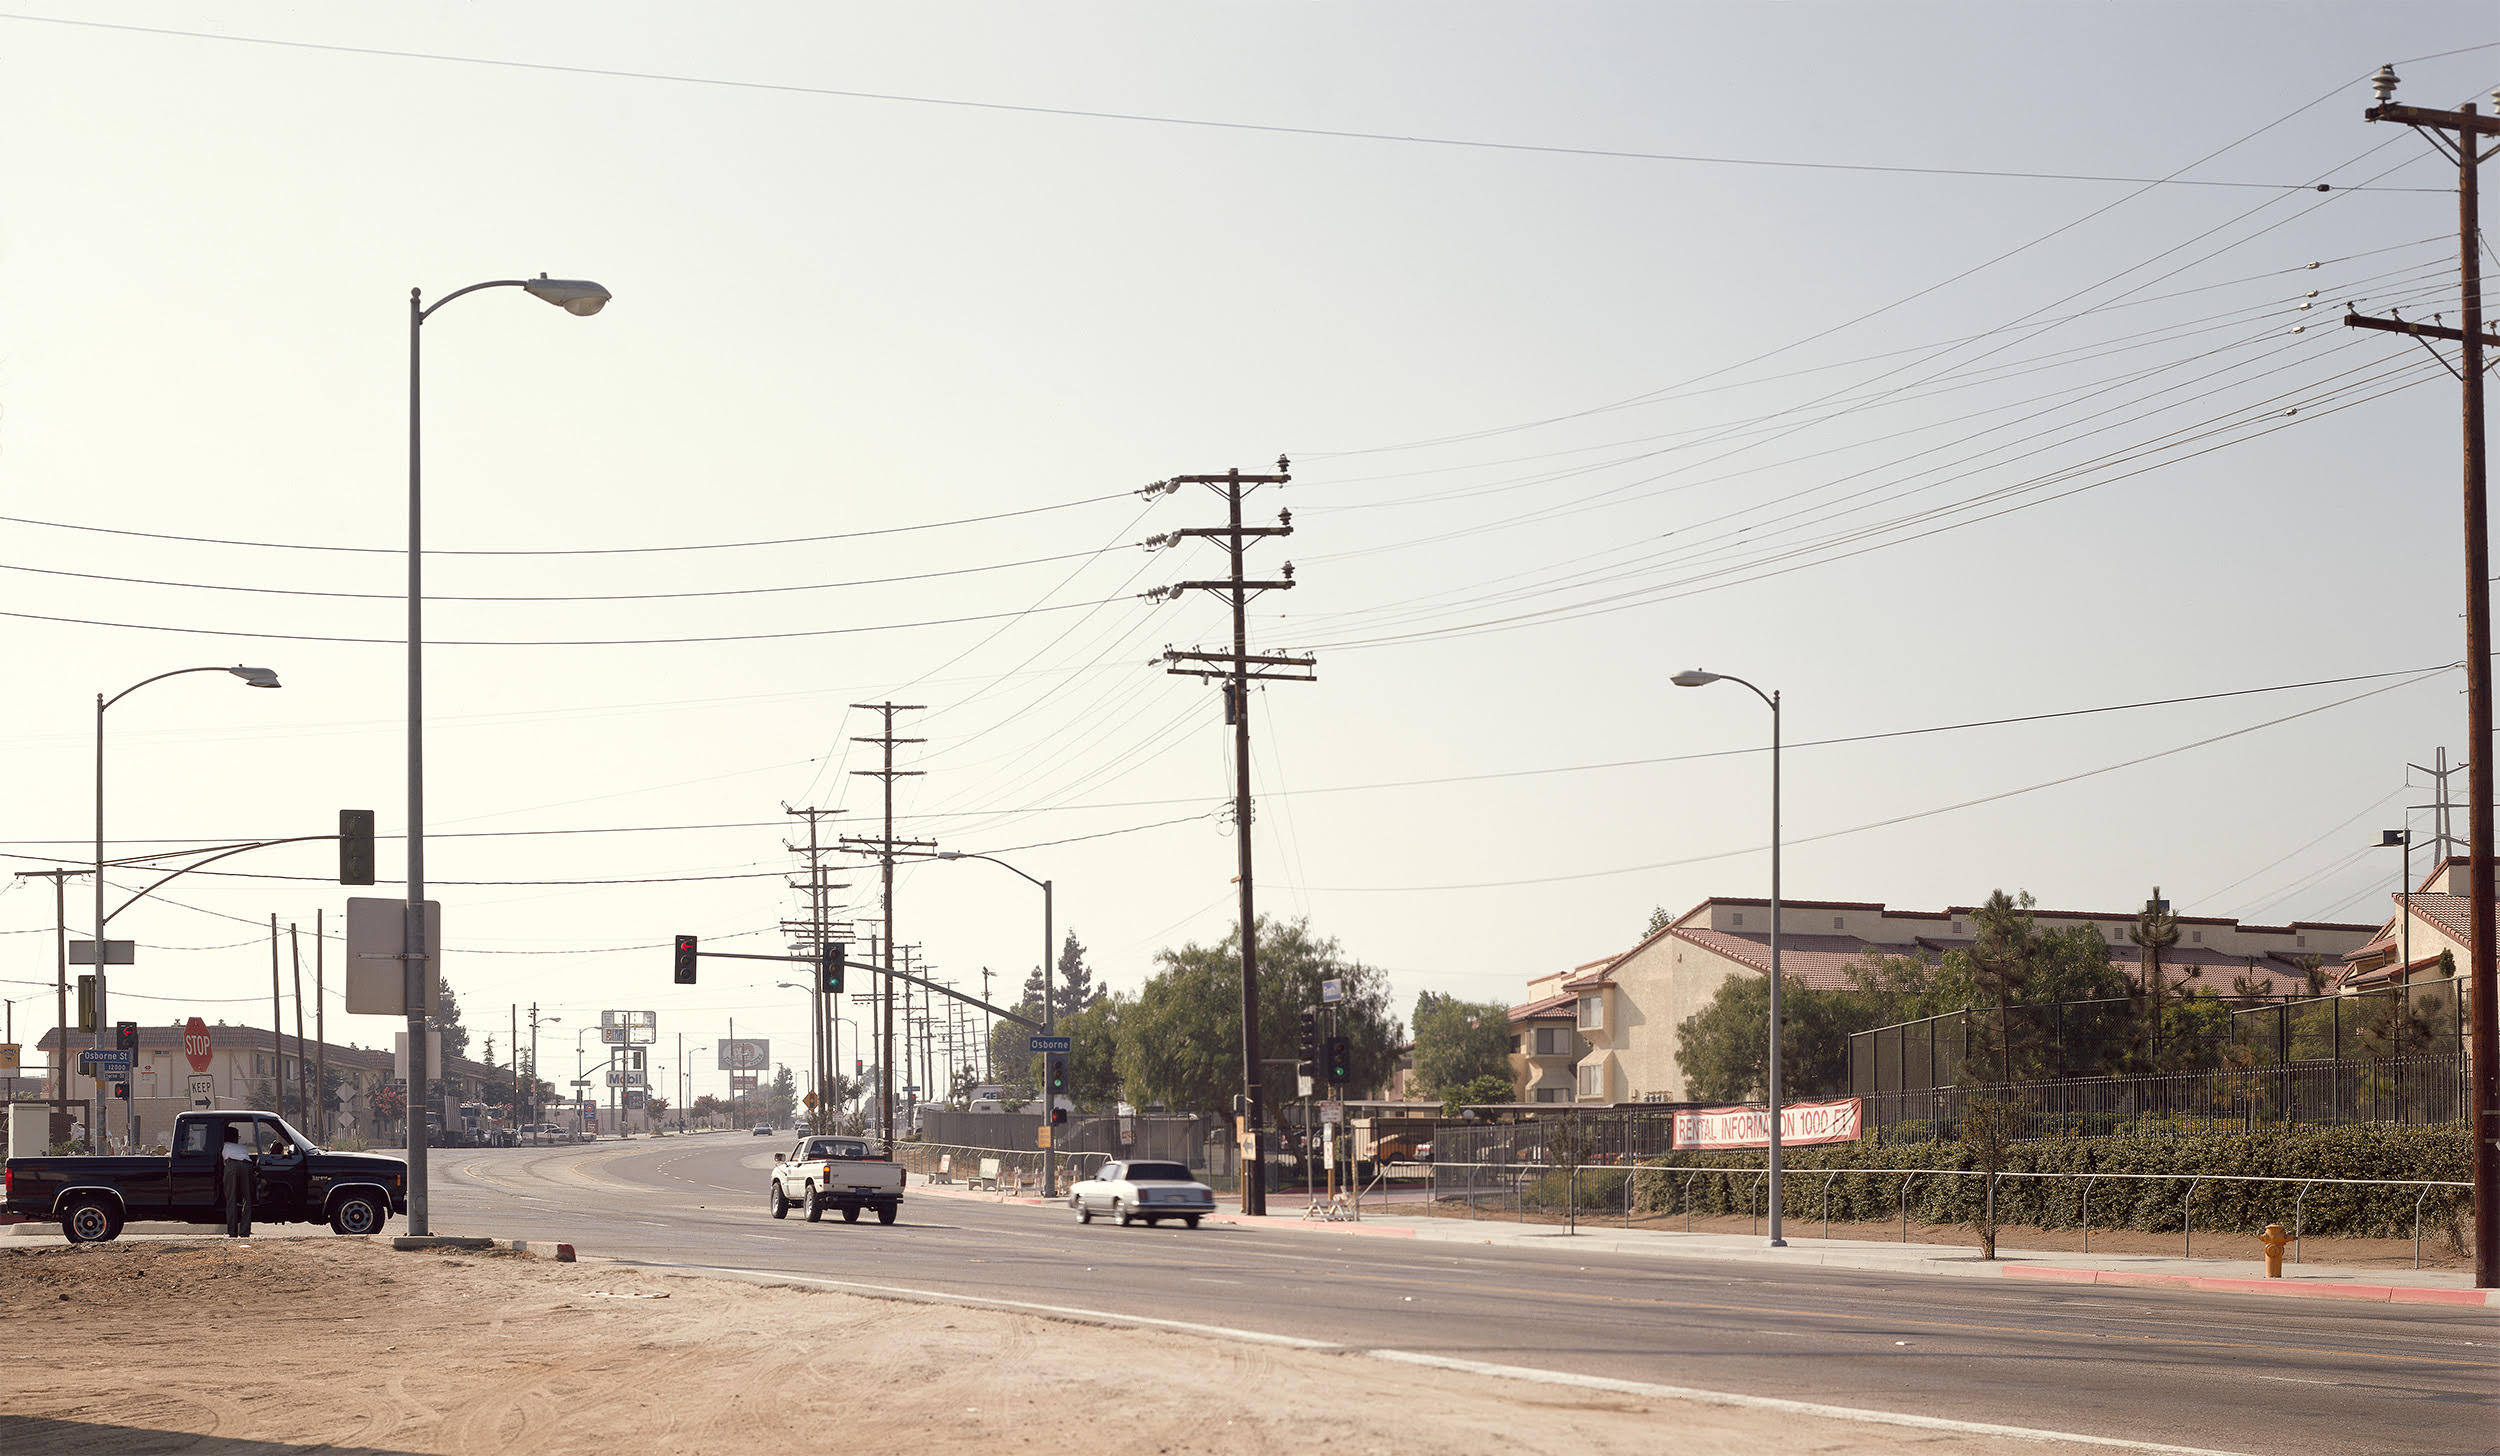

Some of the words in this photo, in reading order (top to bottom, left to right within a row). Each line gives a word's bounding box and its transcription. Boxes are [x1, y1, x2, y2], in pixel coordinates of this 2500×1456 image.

[186, 1034, 210, 1056] STOP
[1032, 1040, 1069, 1049] Osborne
[84, 1052, 117, 1060] Osborne
[120, 1052, 127, 1060] St
[191, 1082, 211, 1094] KEEP
[1679, 1118, 1717, 1142] RENTAL
[1800, 1109, 1829, 1136] 1000
